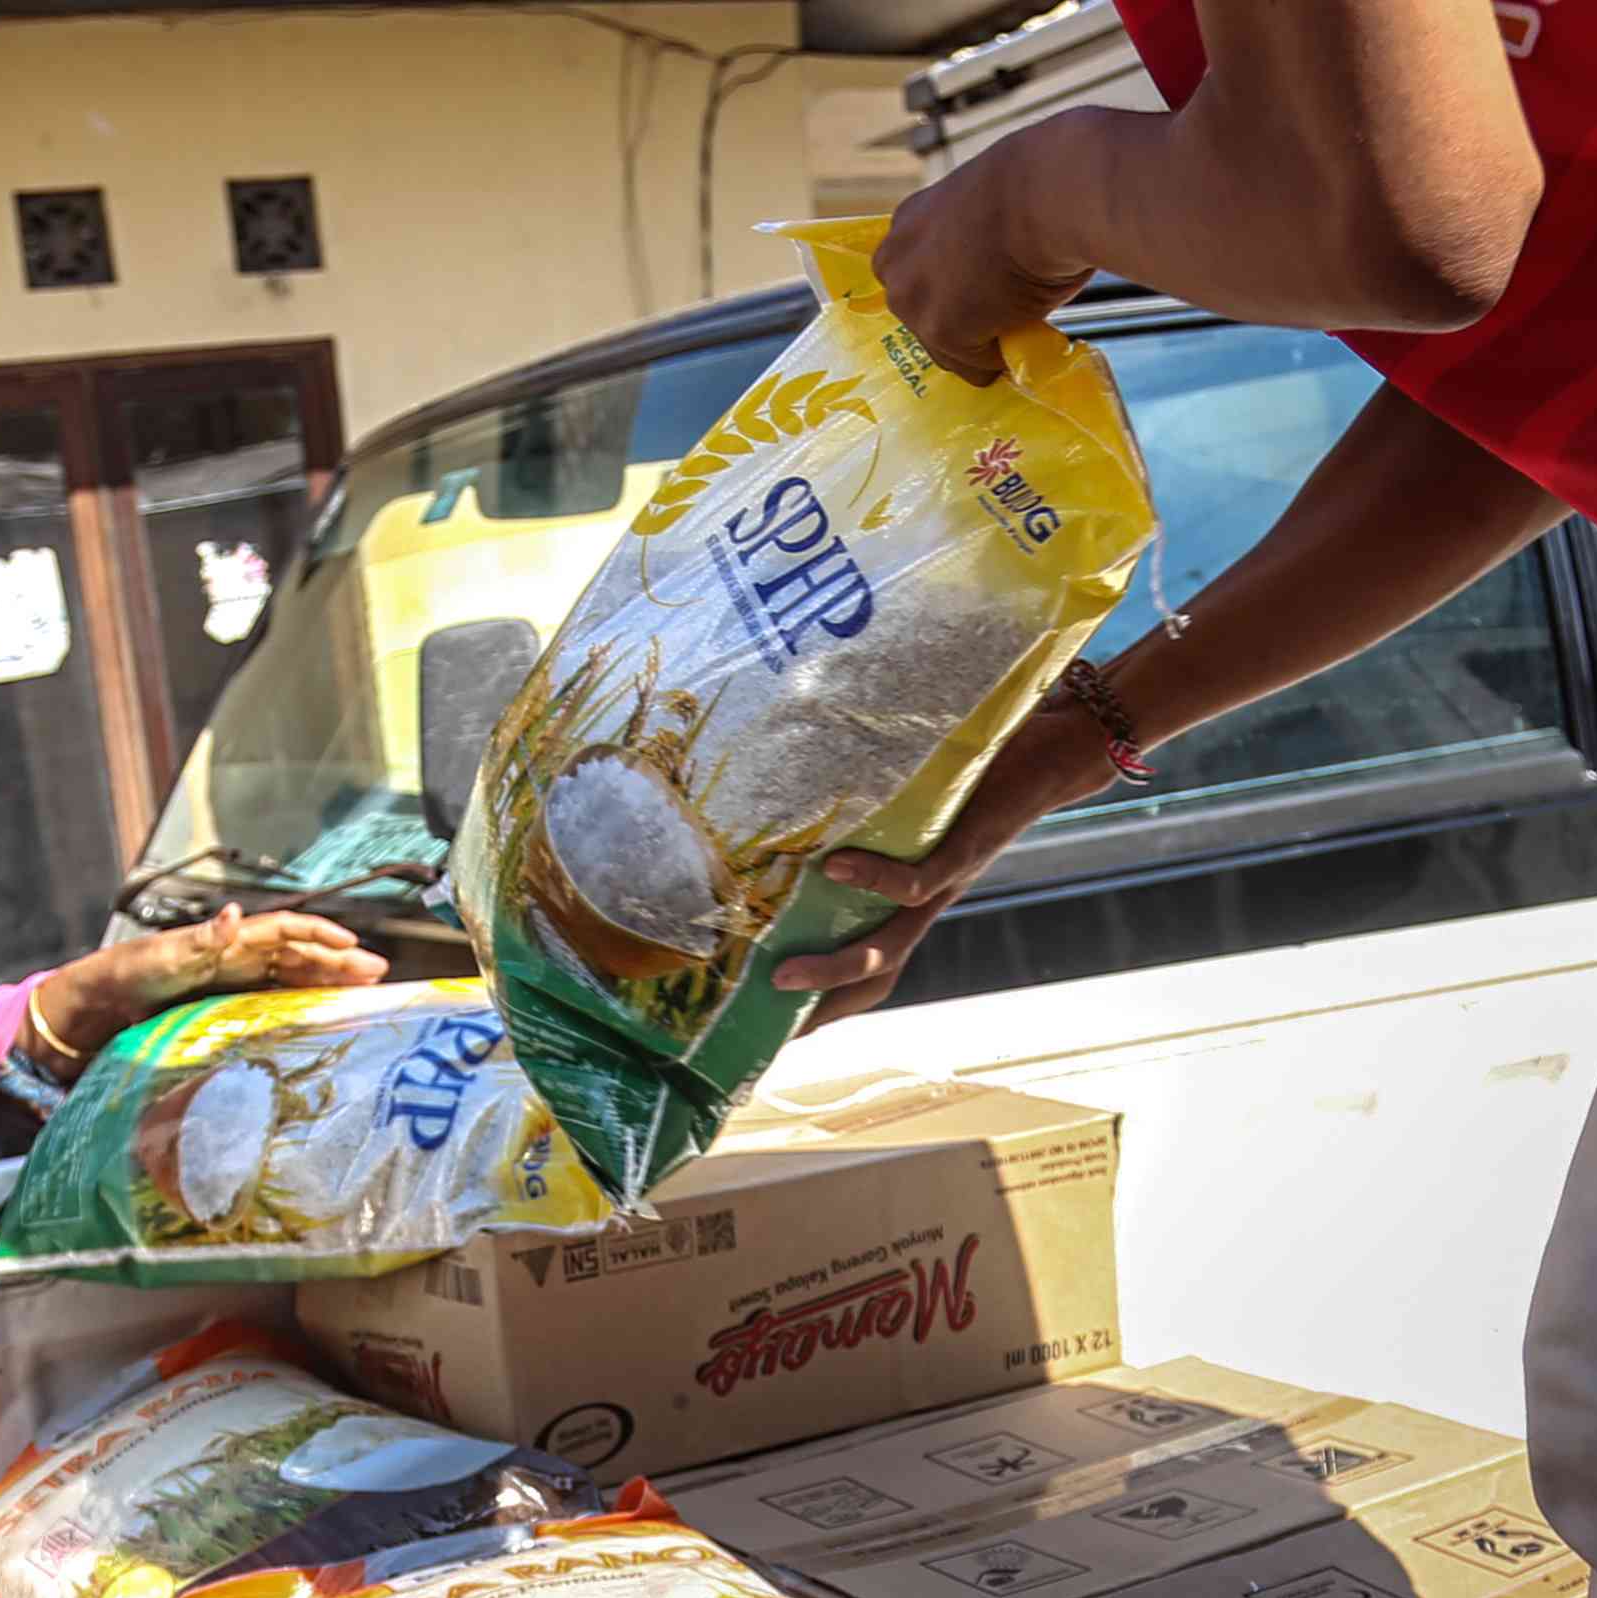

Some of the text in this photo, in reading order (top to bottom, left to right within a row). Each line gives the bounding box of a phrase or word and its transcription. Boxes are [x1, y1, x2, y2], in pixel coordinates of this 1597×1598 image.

[724, 476, 874, 656] SPHP
[388, 1011, 508, 1150] PHP
[891, 1225, 945, 1252] Minyak
[563, 1248, 599, 1276] SNI
[609, 1245, 662, 1264] HALAL
[830, 1245, 888, 1275] Goreng
[774, 1266, 829, 1296] Kelapa
[695, 1233, 980, 1397] Mamayo
[1005, 1330, 1114, 1372] 12 X 1000 ml
